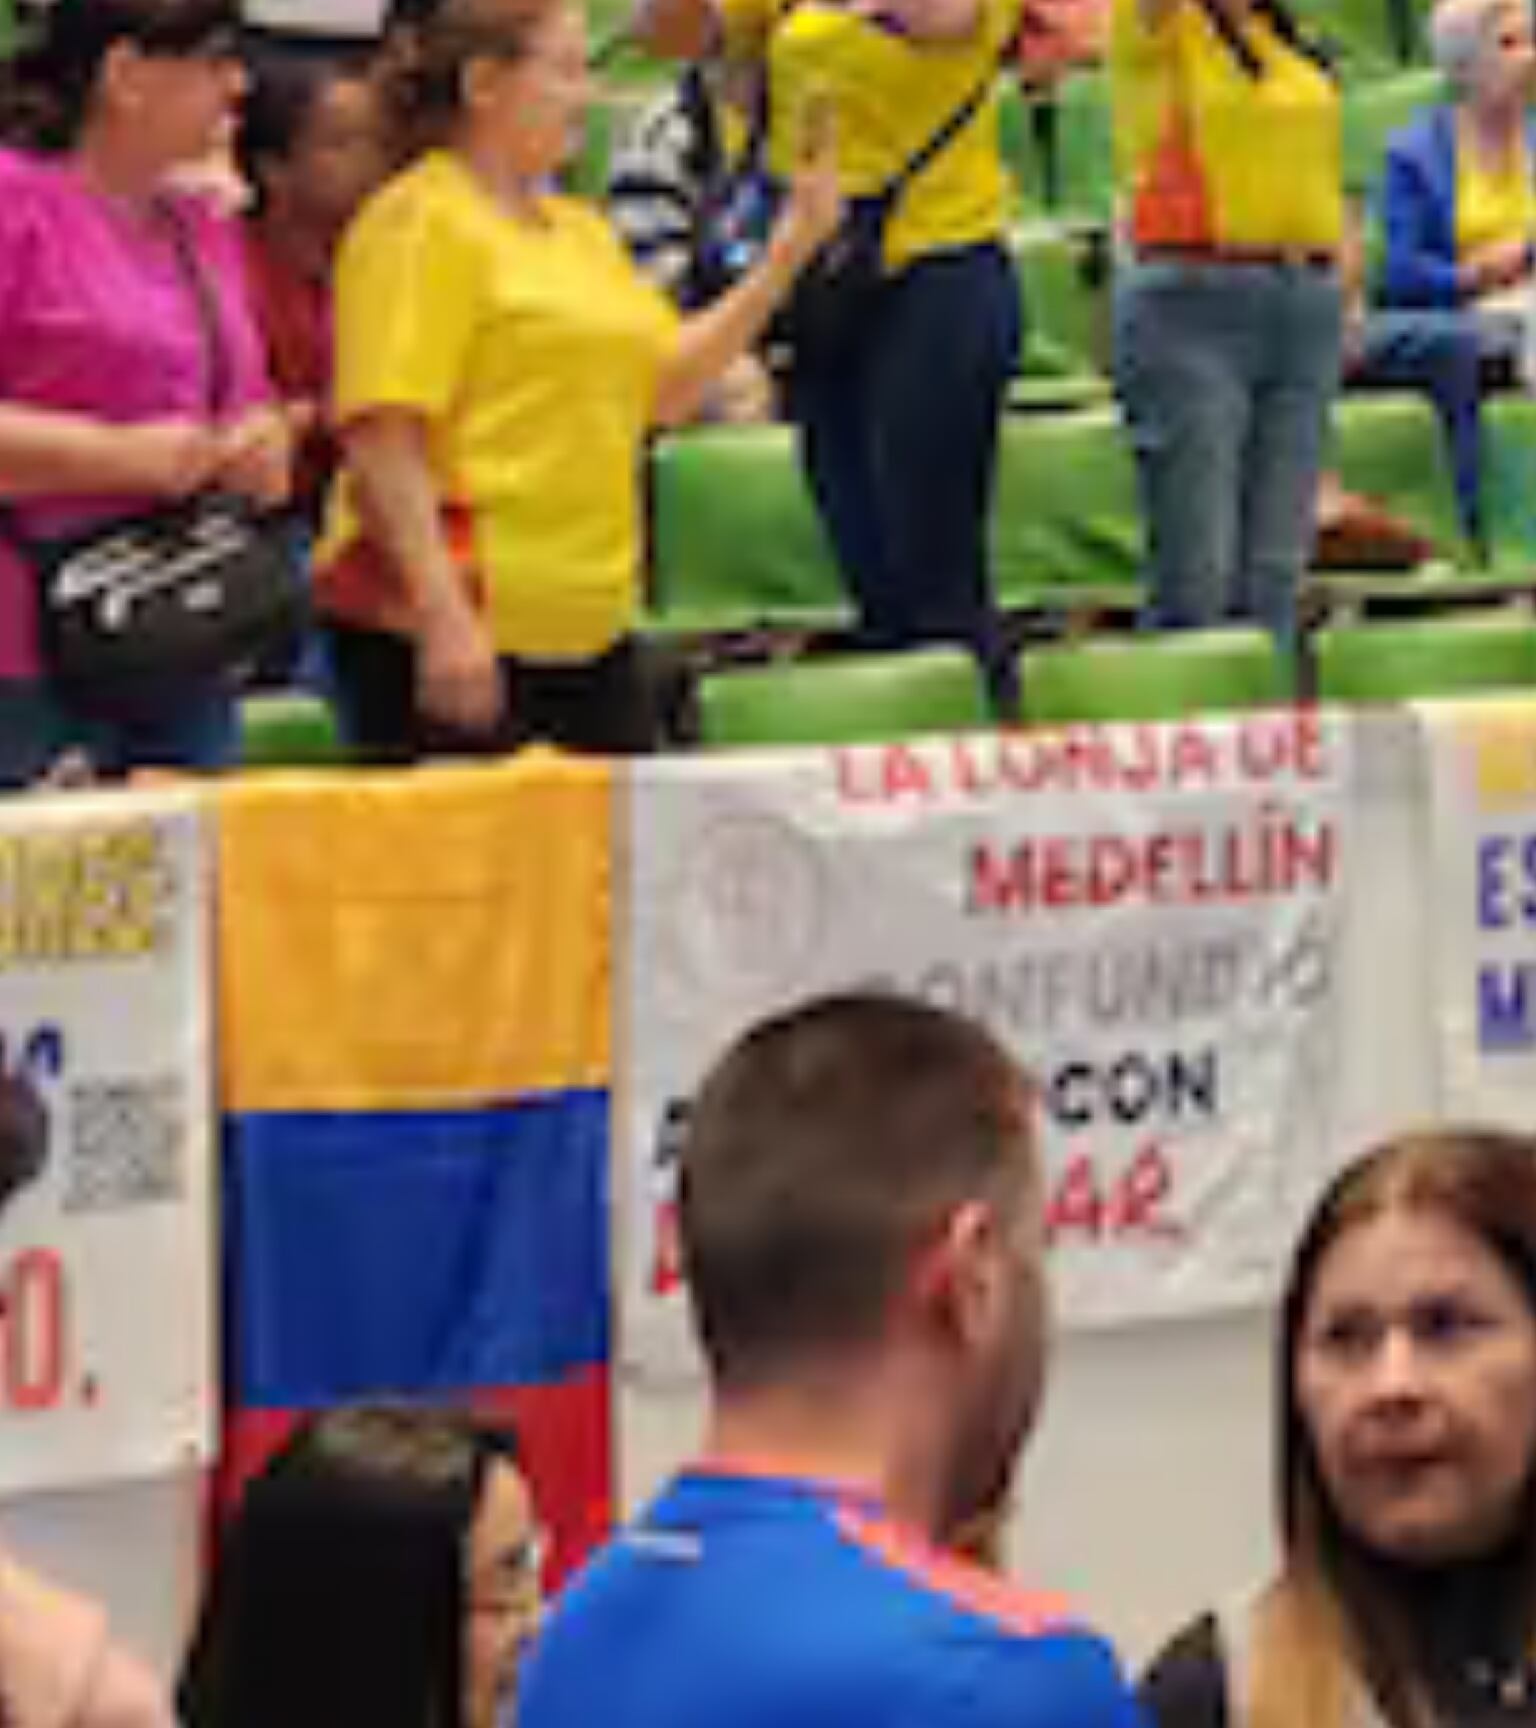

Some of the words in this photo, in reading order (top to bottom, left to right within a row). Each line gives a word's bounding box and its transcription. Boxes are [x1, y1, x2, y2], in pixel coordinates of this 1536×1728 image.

[836, 740, 932, 806] LA
[952, 722, 1218, 796] LONJA
[1236, 700, 1326, 784] DE
[964, 798, 1336, 914] MEDELLÍN
[1046, 1048, 1220, 1126] CON
